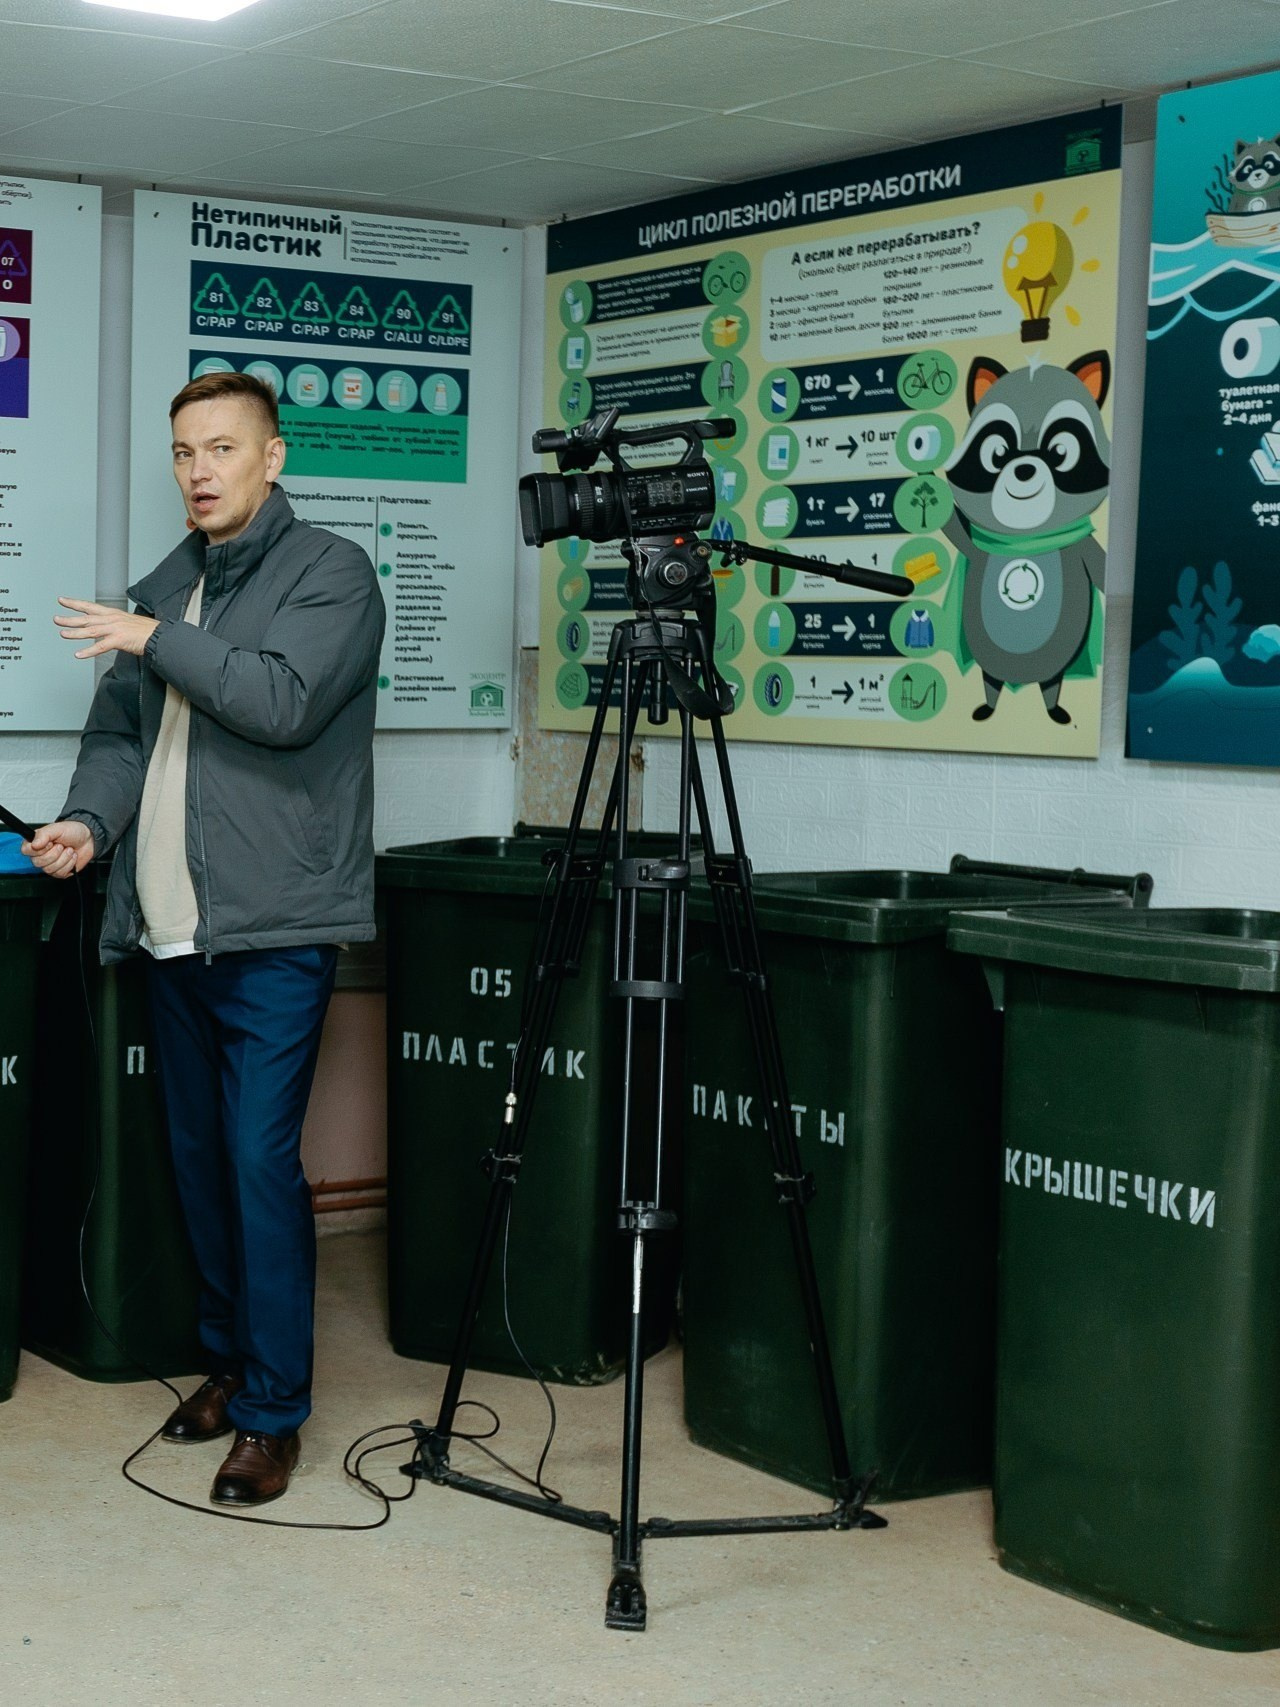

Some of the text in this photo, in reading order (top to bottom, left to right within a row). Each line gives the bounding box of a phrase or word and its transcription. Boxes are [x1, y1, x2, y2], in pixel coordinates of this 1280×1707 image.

[638, 164, 962, 248] ЦИКЛ ПОЛЕЗНОЙ ПЕРЕРАБОТКИ
[191, 202, 342, 235] Нетипичный
[191, 222, 321, 257] Пластик
[790, 222, 981, 266] А если не перерабатывать?
[0, 256, 15, 266] 07
[2, 279, 13, 290] O
[208, 291, 455, 324] 81 82 83 84 90 91
[195, 314, 469, 348] C/PAP C/PAP C/PAP C/PAP C/ALU C/LDPE
[804, 373, 831, 391] 670
[875, 367, 884, 383] 1
[1219, 384, 1280, 399] туалетная
[1221, 399, 1263, 414] бумага
[1248, 412, 1272, 426] дня
[805, 435, 830, 448] 1 кг
[860, 429, 898, 443] 10 шт
[806, 496, 826, 511] 1 т
[868, 492, 886, 508] 17
[804, 613, 822, 629] 25
[867, 613, 875, 629] 1
[809, 675, 816, 689] 1
[858, 677, 865, 690] 1
[470, 966, 512, 998] 05
[692, 1083, 845, 1147] ПАКТЫ
[1005, 1147, 1216, 1229] КРЫШЕЧКИ
